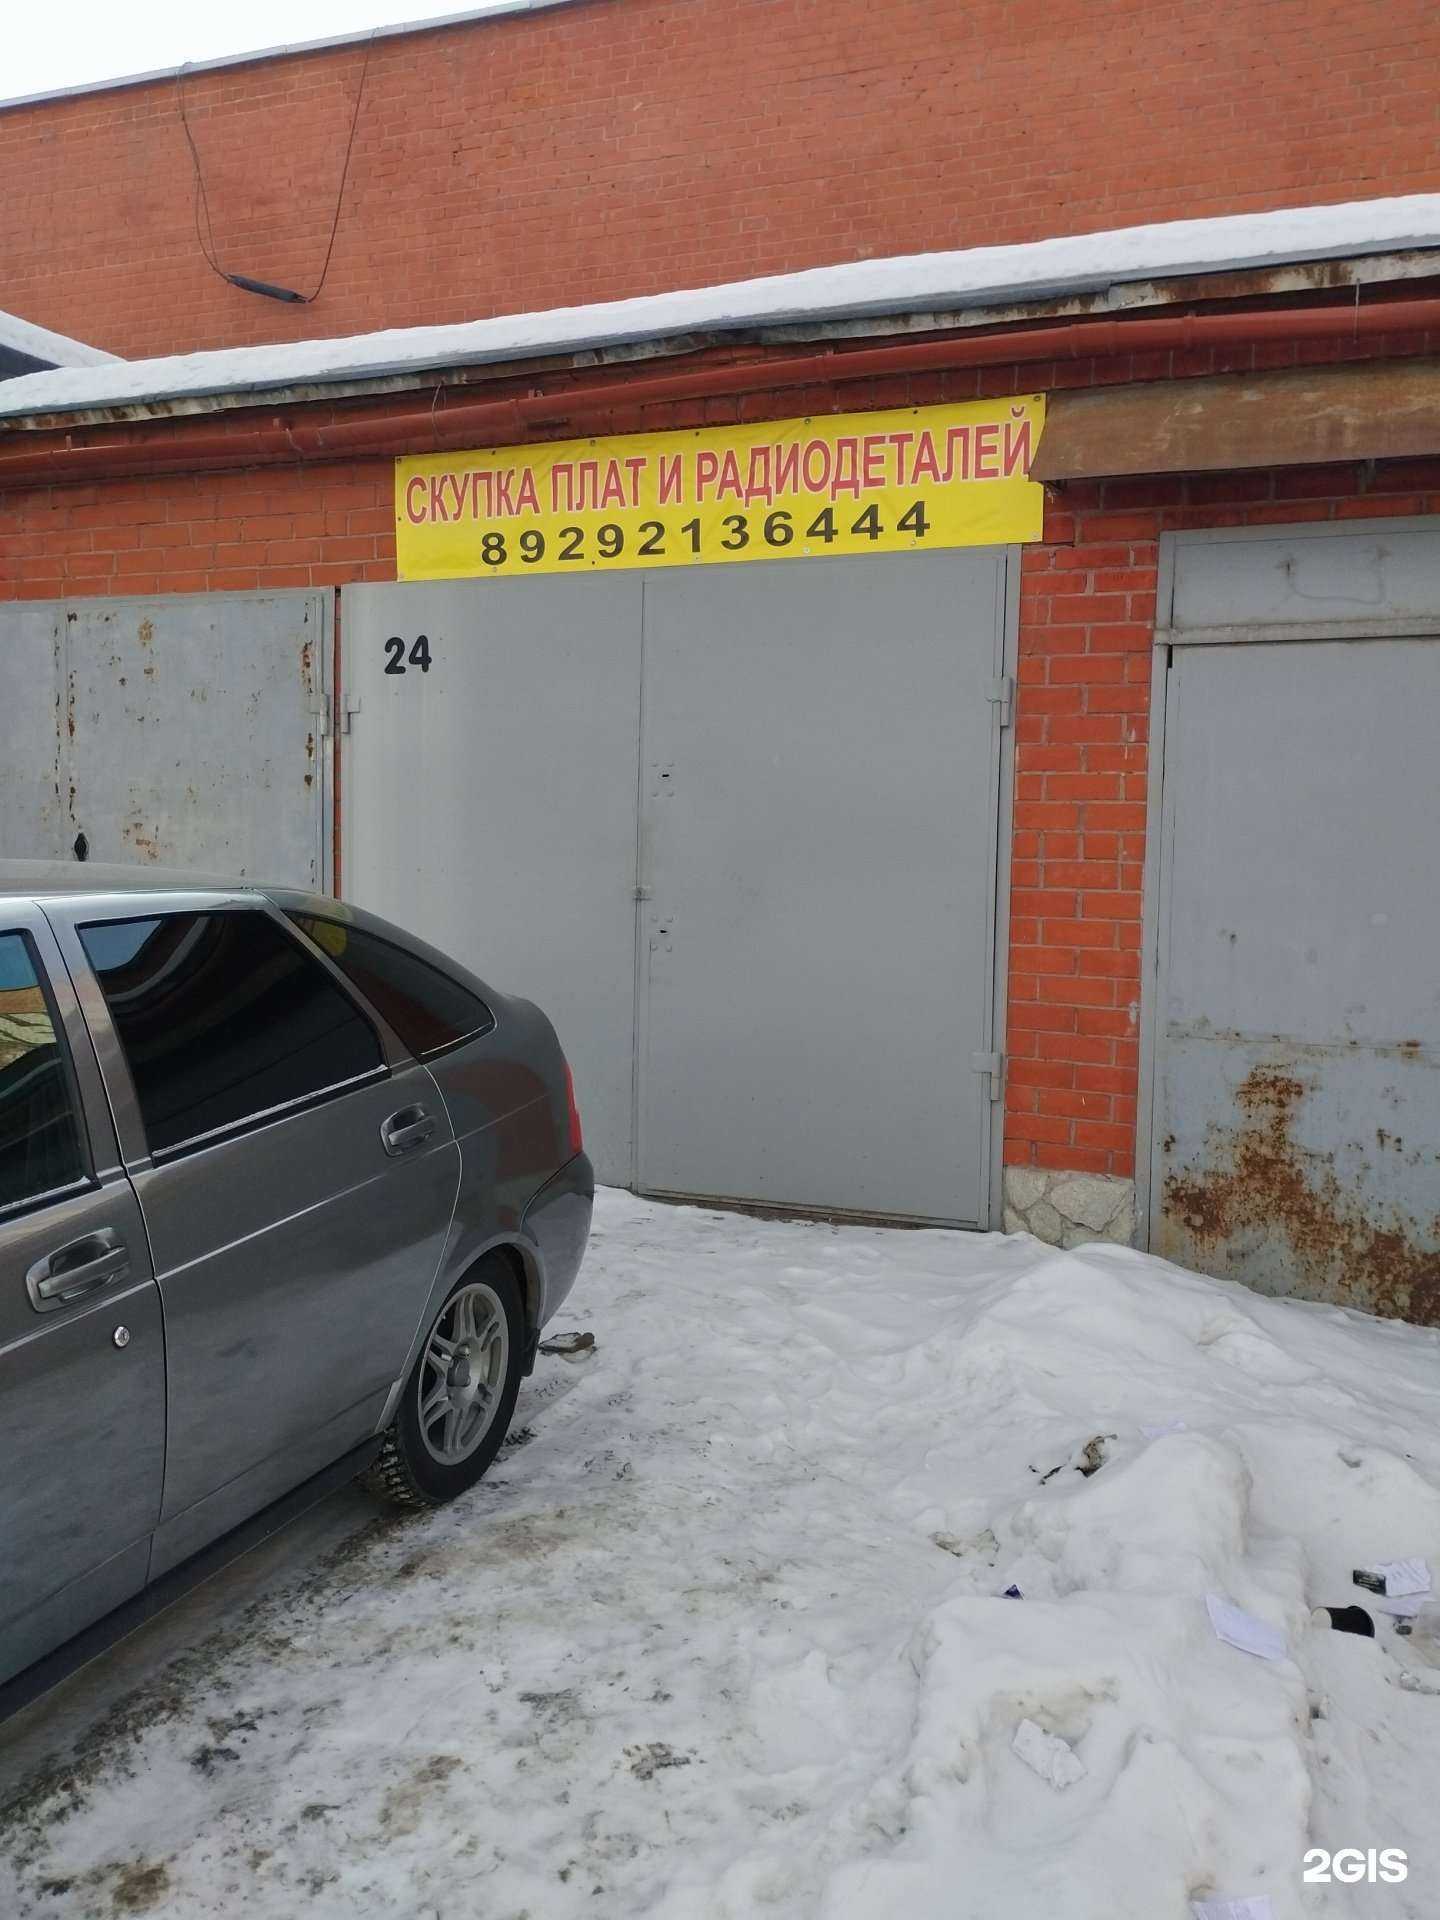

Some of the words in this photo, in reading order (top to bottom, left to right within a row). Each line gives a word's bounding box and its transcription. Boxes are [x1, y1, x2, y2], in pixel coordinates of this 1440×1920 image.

[406, 468, 541, 524] СКУПКА
[551, 457, 647, 512] ПЛАТ
[658, 453, 683, 505] И
[695, 405, 1032, 508] РАДИОДЕТАЛЕЙ
[481, 501, 931, 566] 89292136444
[384, 634, 433, 675] 24
